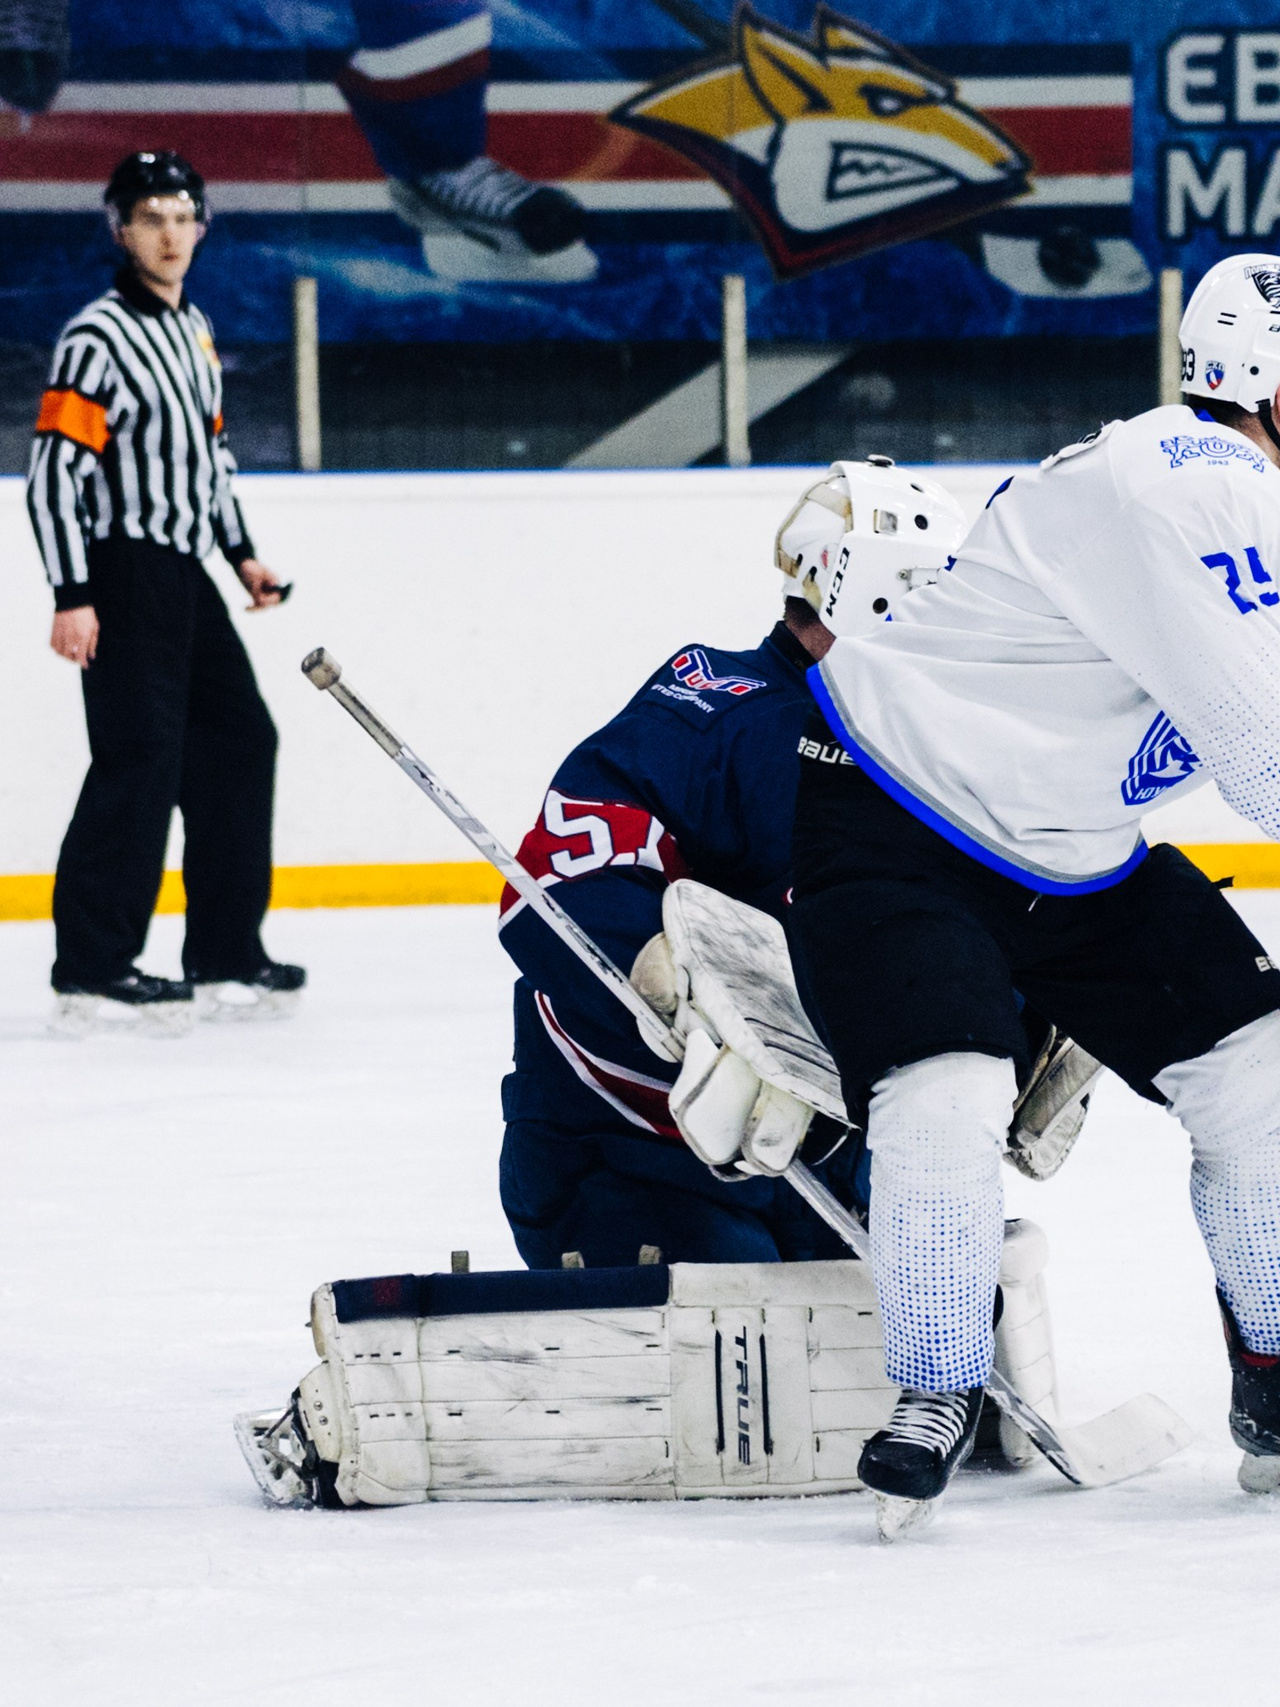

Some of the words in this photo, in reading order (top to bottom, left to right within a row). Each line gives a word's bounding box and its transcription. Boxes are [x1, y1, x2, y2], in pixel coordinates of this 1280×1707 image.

[825, 547, 851, 618] CCM
[797, 735, 857, 766] BAUE
[734, 1325, 751, 1466] TRUE
